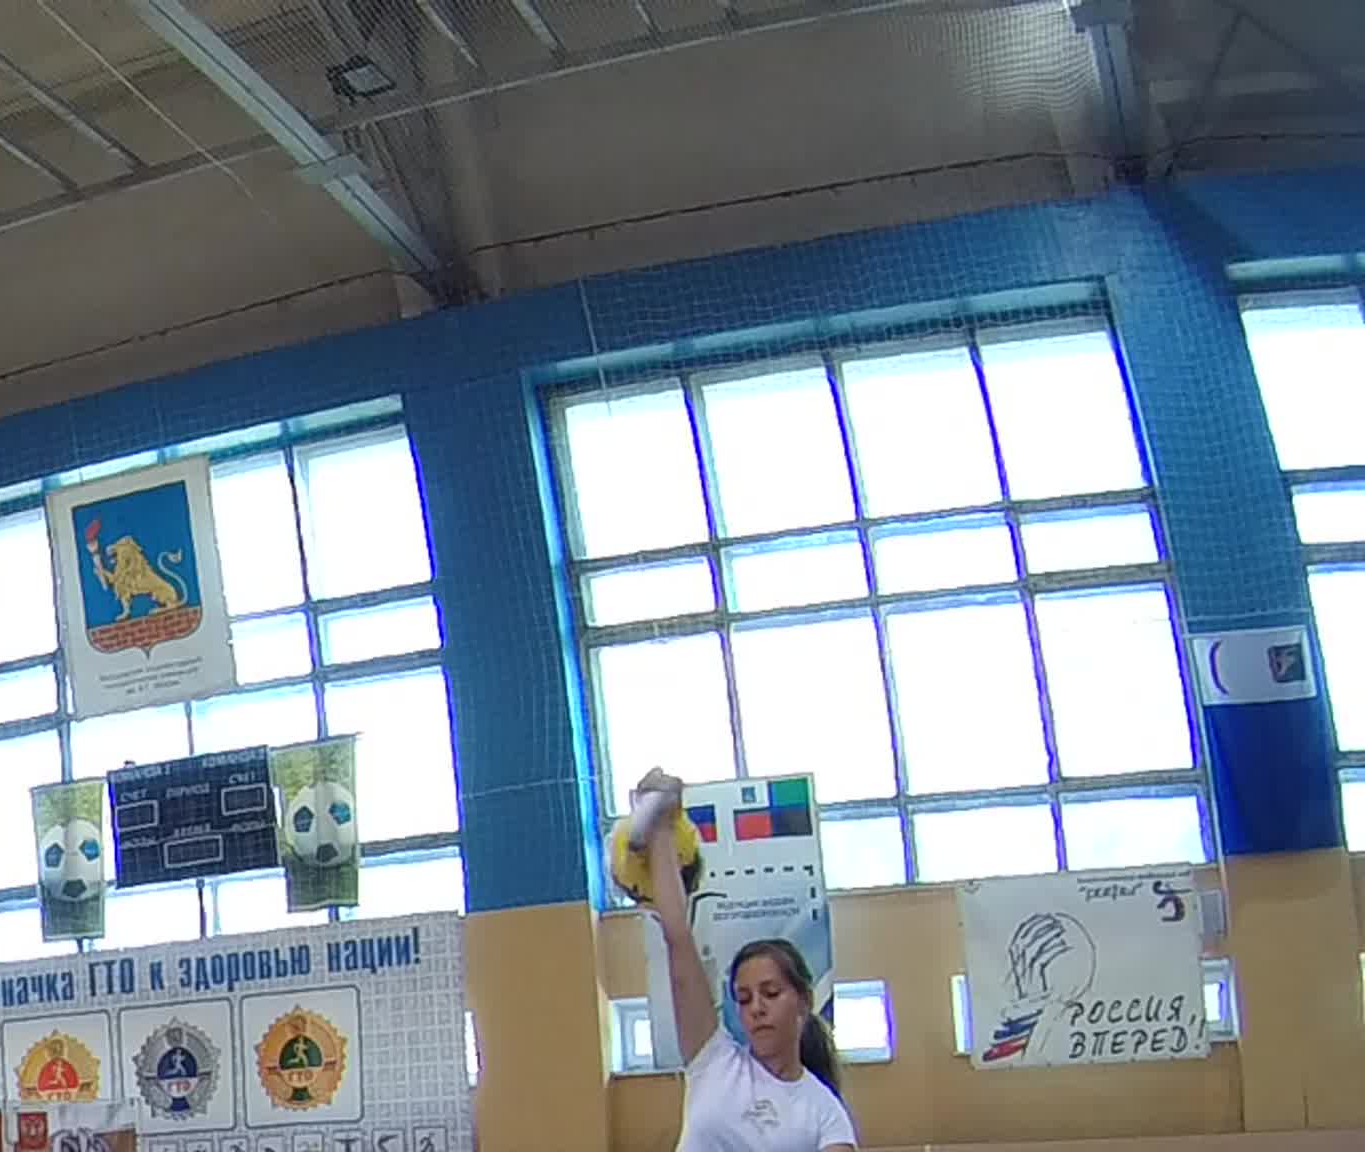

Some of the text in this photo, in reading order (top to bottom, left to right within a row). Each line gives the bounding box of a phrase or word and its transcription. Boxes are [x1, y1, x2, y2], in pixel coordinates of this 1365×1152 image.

[88, 957, 134, 997] ГТО
[149, 960, 165, 991] к
[179, 944, 311, 992] здоровью
[327, 927, 422, 974] нации!
[1068, 994, 1196, 1026] РОССИЯ,
[1069, 1018, 1206, 1058] ВПЕРЕД!
